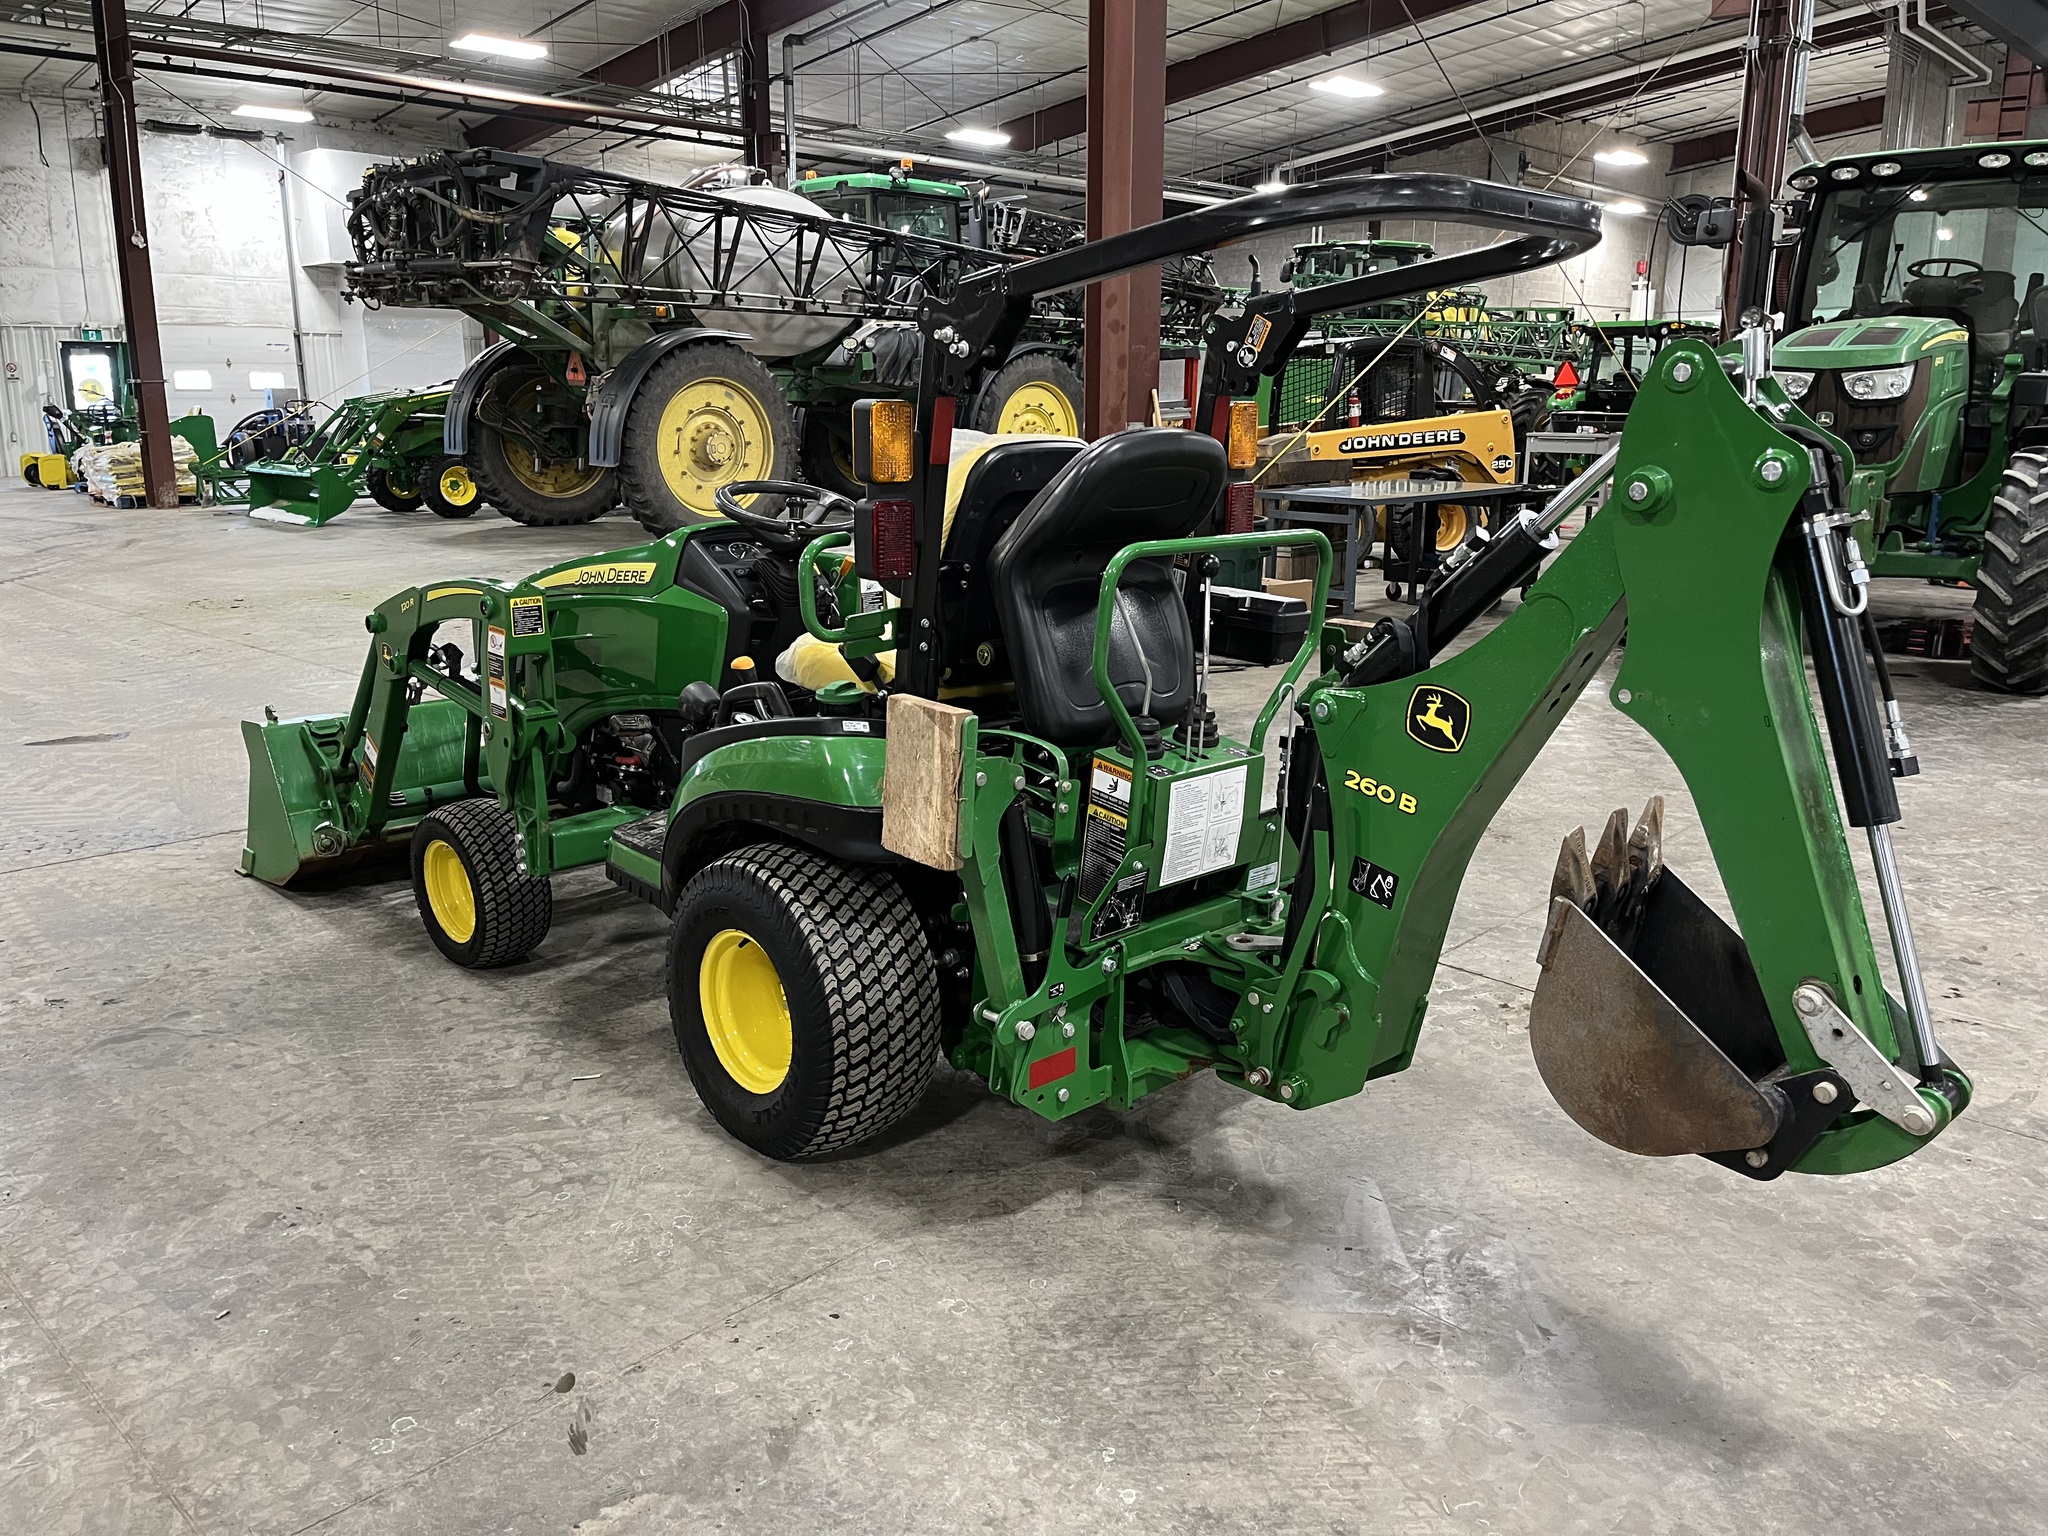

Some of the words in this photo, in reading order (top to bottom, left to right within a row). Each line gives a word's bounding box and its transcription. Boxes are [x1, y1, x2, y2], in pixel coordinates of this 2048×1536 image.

[1341, 433, 1396, 451] JOHN
[1398, 428, 1461, 446] DEERE
[1491, 458, 1514, 469] 250
[574, 569, 605, 585] JOHN
[606, 568, 648, 584] DEERE
[1103, 764, 1132, 781] WARNING
[1343, 768, 1397, 805] 260
[1397, 792, 1418, 815] B
[1099, 811, 1126, 827] CAUTION
